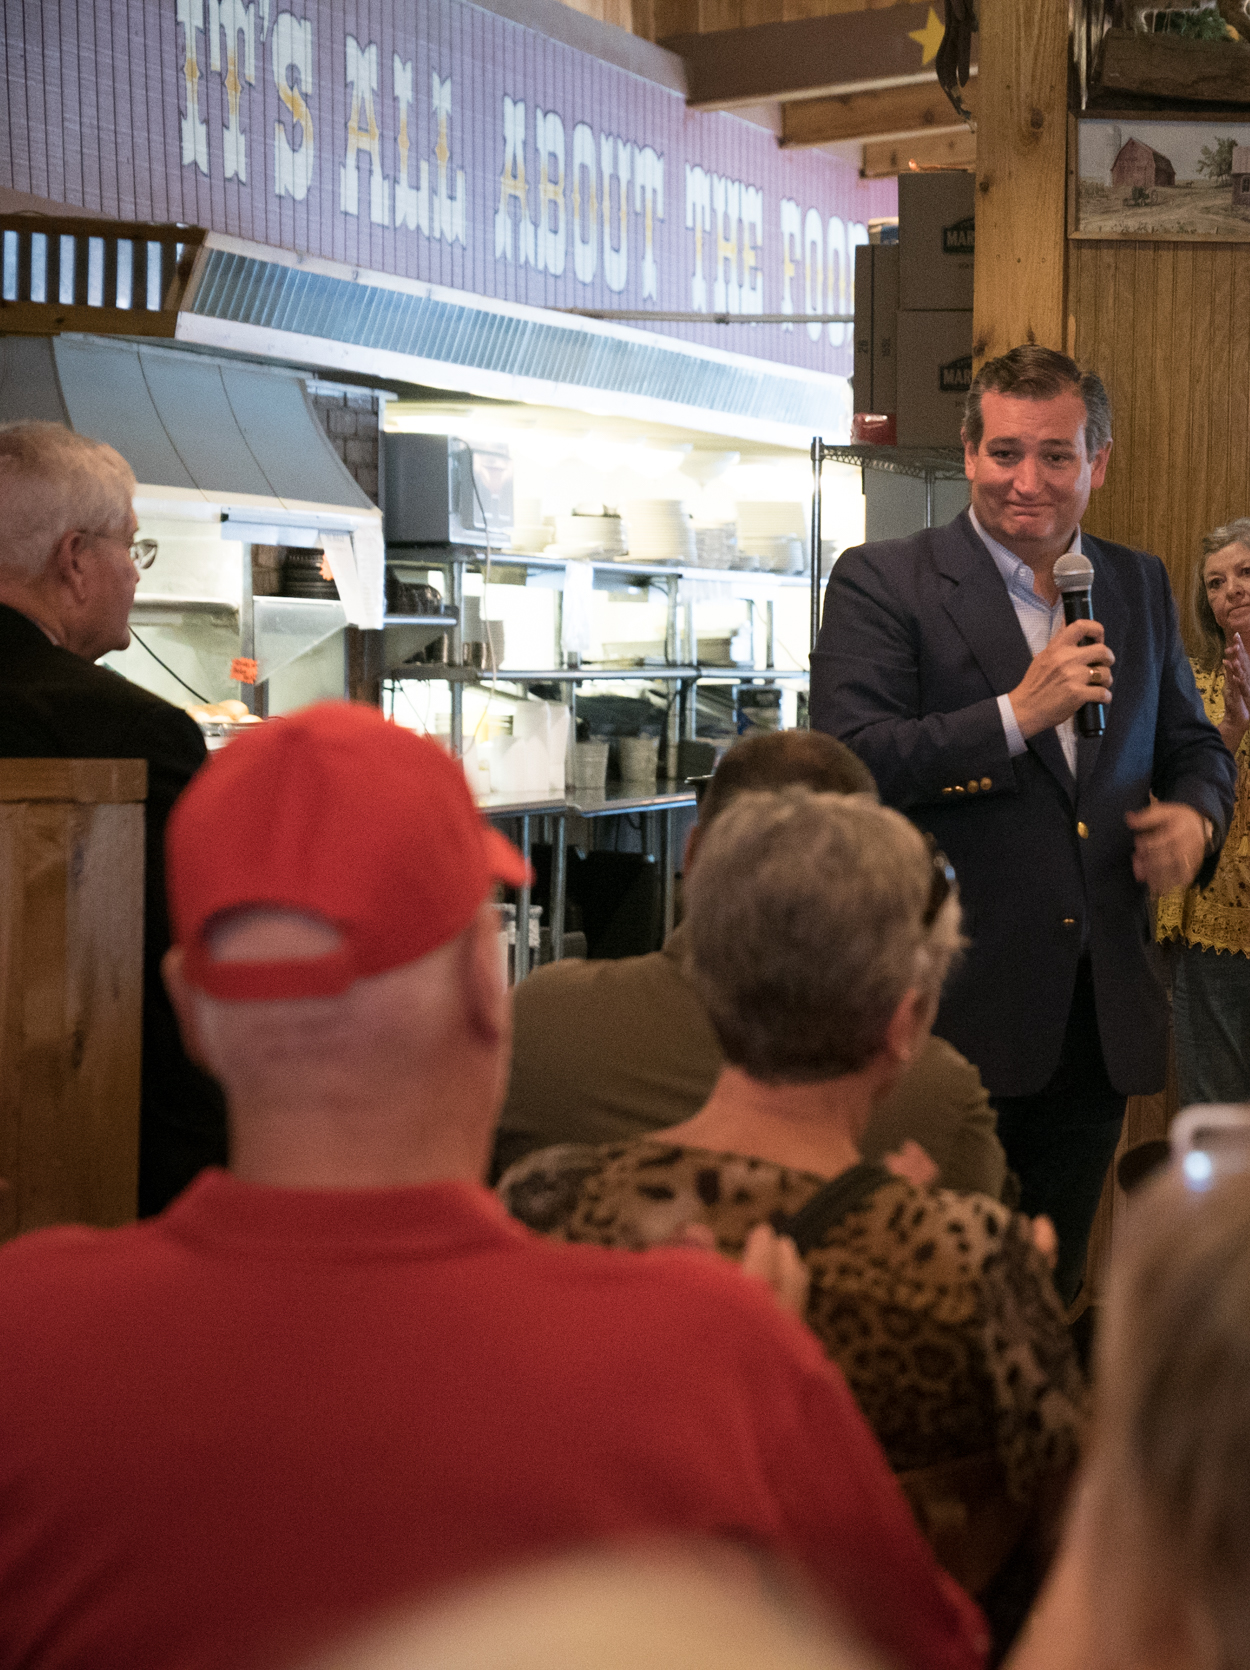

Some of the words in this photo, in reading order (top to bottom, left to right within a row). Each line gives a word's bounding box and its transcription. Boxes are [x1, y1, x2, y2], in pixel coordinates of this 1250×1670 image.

[175, 0, 314, 202] IT'S
[339, 33, 467, 248] ALL
[494, 94, 665, 301] ABOUT
[684, 163, 764, 328] THE
